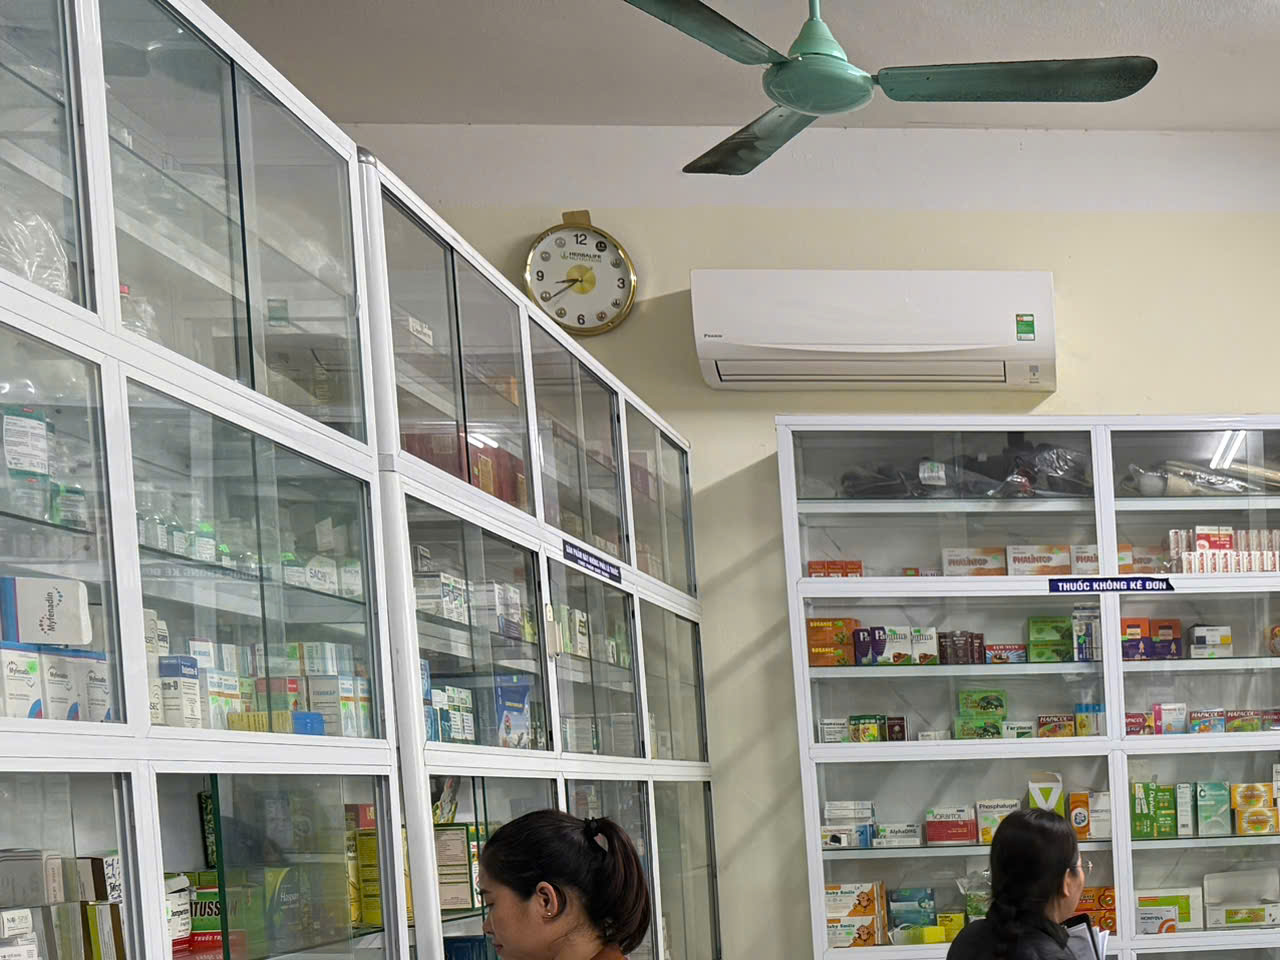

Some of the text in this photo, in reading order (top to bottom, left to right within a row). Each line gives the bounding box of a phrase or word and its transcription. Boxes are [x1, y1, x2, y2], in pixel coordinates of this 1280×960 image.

[573, 233, 587, 246] 12
[536, 270, 545, 282] 9
[617, 278, 626, 289] 3
[577, 314, 586, 325] 6
[1057, 579, 1167, 591] THUỐC KHÔNG KÊ ĐƠN
